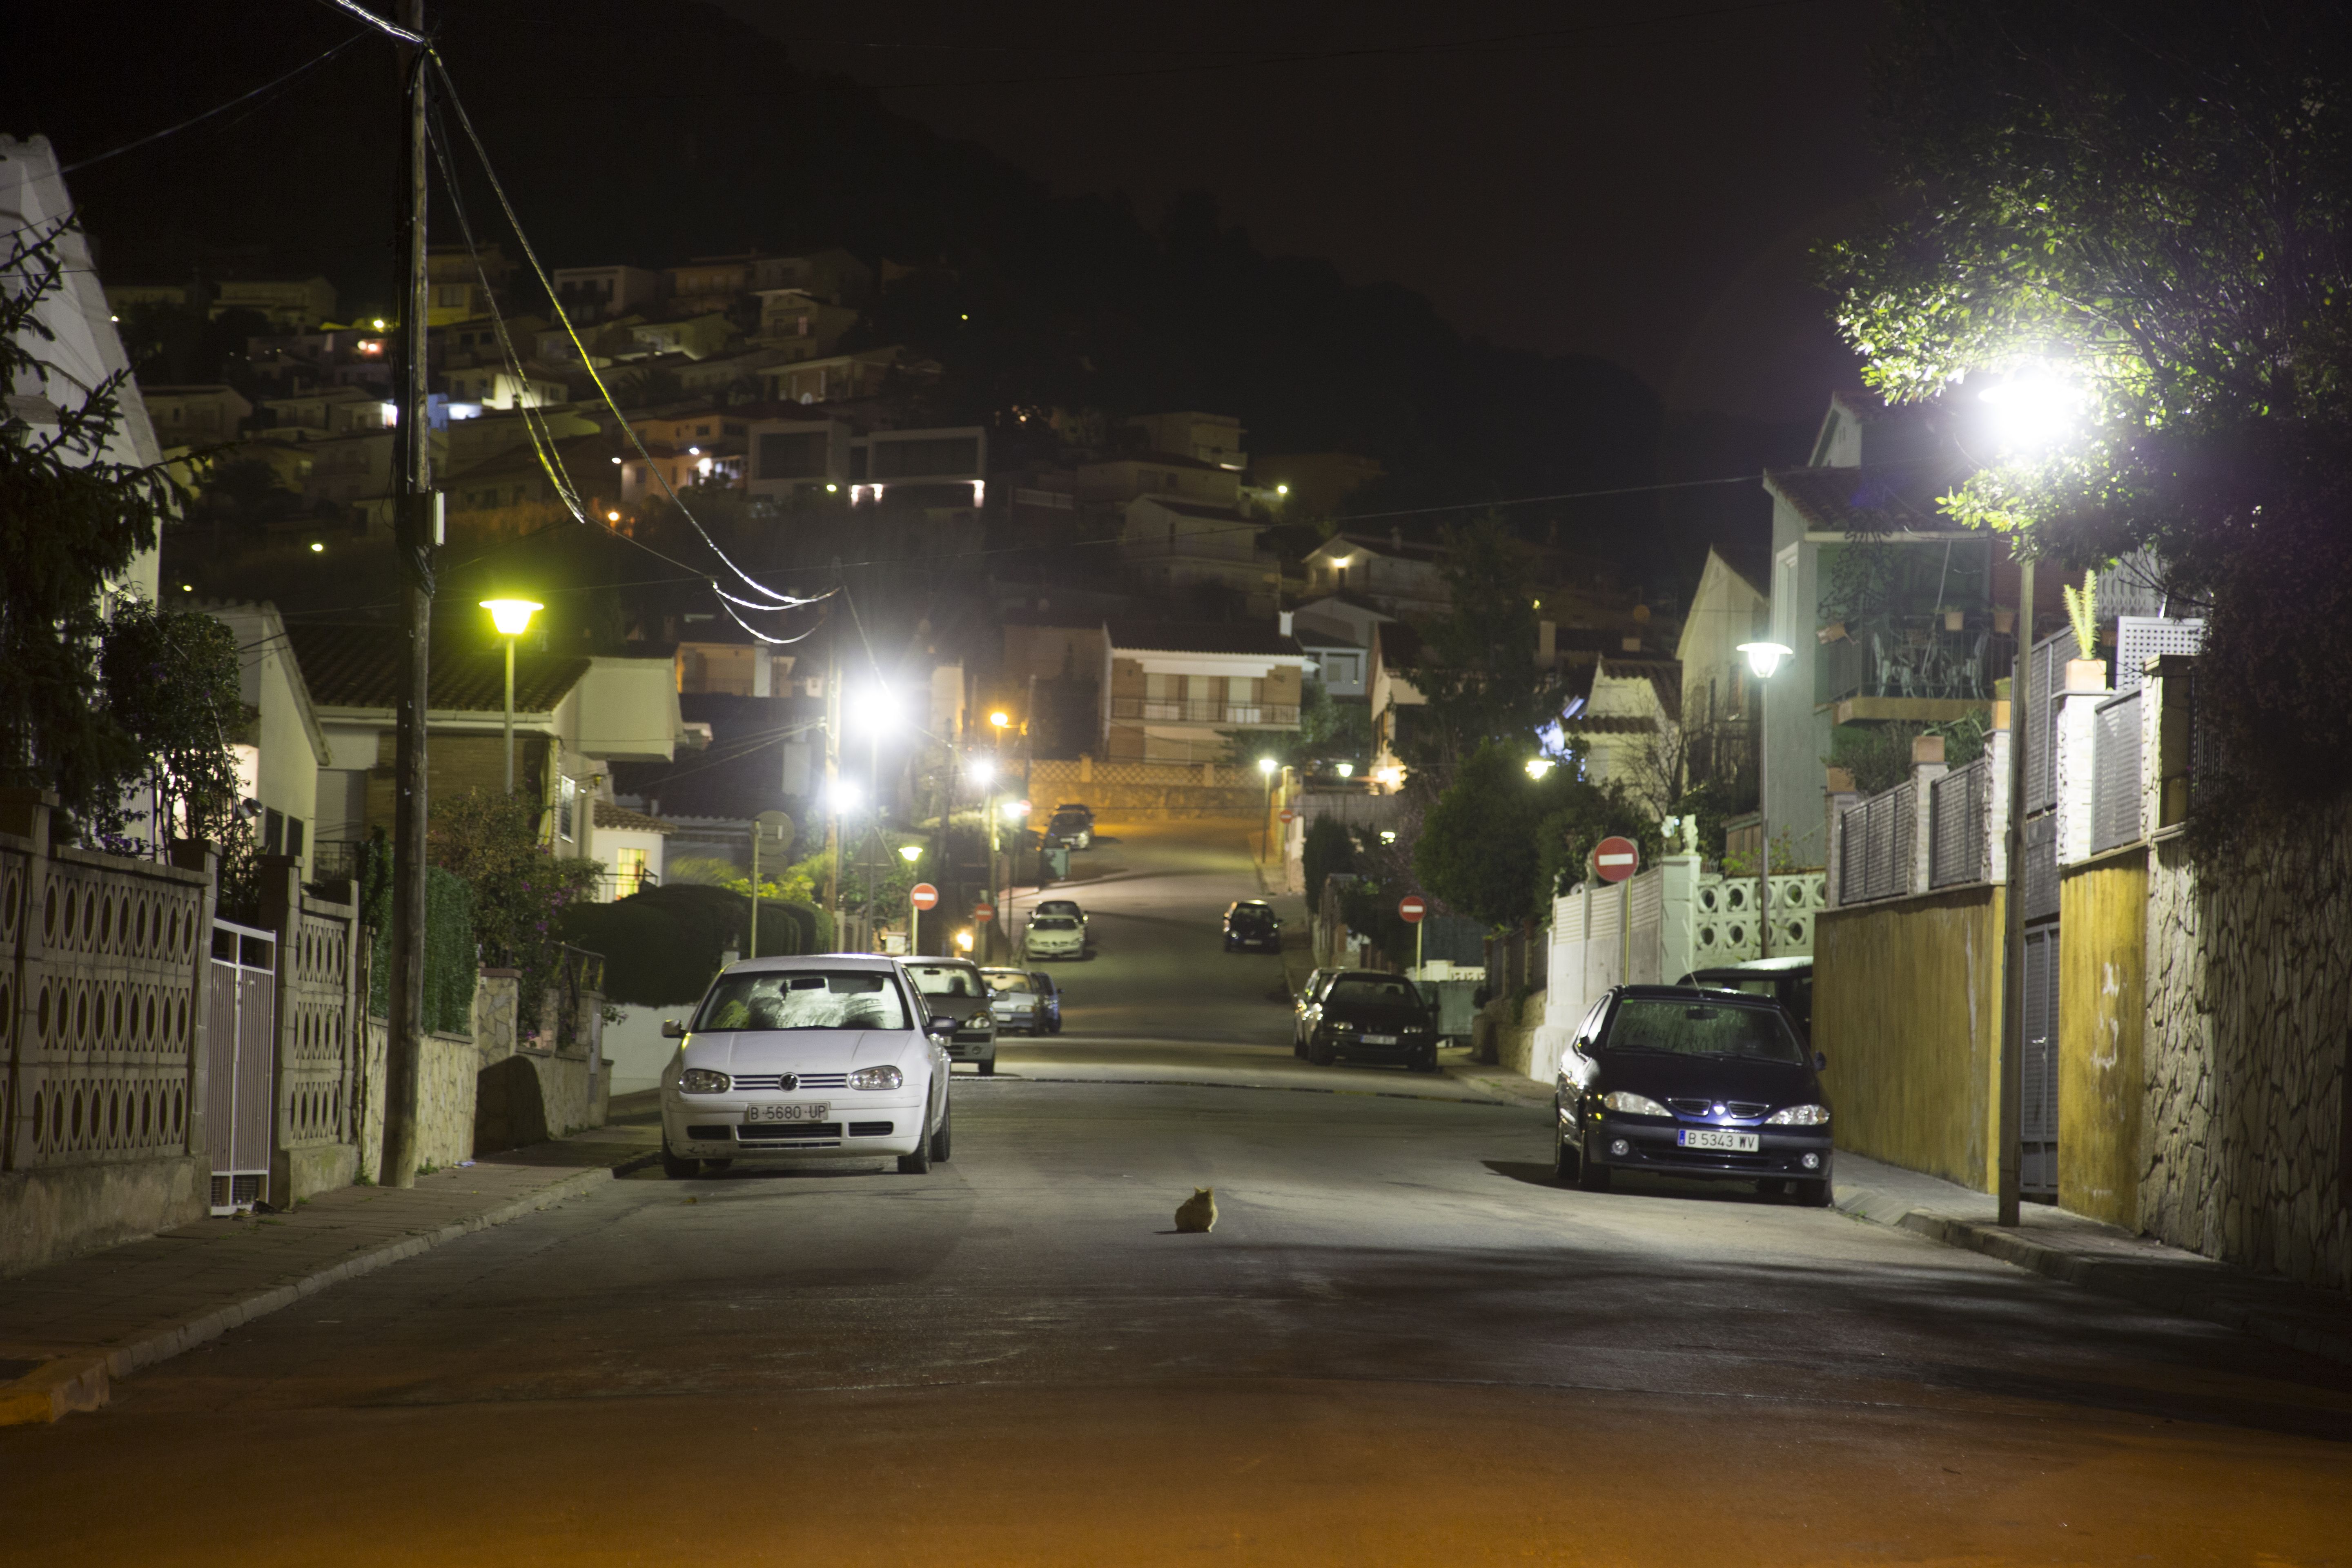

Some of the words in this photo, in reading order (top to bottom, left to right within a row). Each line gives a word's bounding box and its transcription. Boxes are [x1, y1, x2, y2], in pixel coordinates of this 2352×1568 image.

[1688, 1132, 1696, 1145] B
[1701, 1133, 1733, 1147] 5343
[1739, 1136, 1755, 1148] WV
